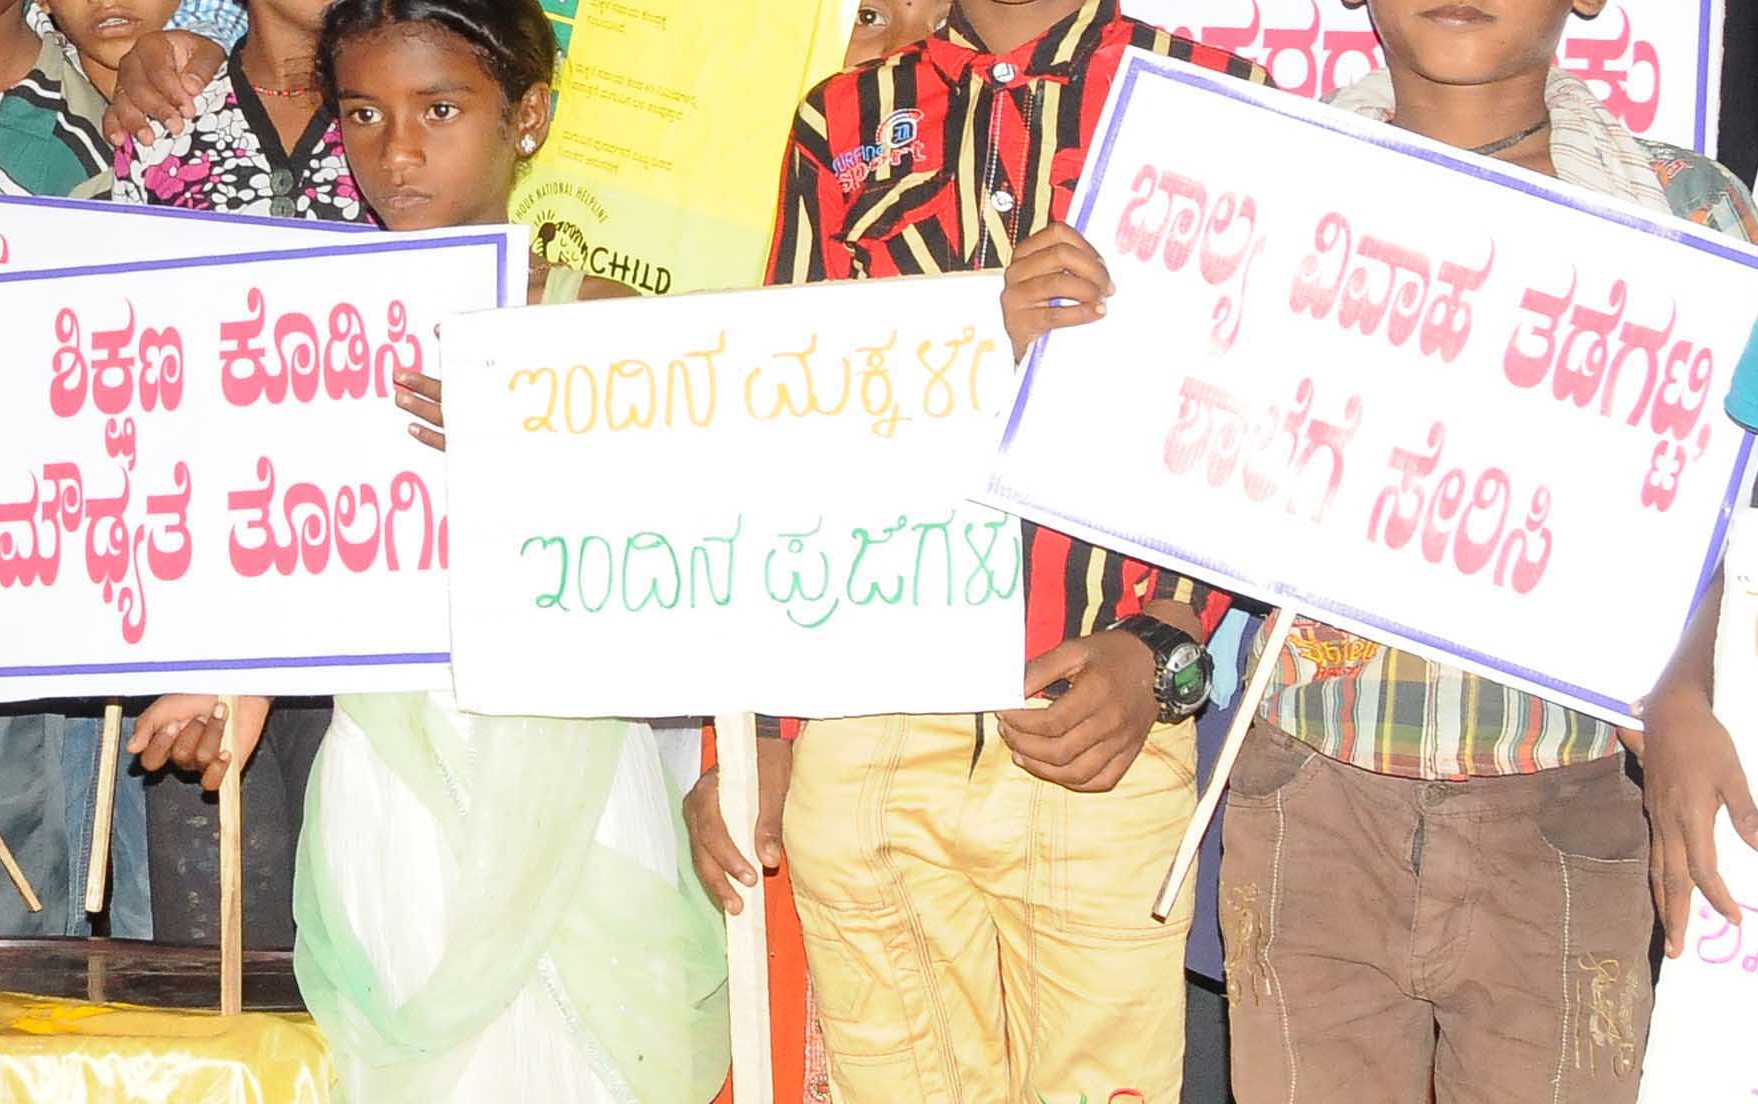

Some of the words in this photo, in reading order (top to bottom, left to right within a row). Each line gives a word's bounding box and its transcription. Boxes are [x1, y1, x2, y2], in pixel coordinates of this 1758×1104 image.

[590, 247, 671, 295] CHILD
[1289, 211, 1496, 363] ವಿವಾಹ
[49, 296, 184, 471] ಶಿಕ್ಷಣ
[227, 456, 449, 578] ತೊಲಗಿ
[1367, 420, 1552, 596] ಸೇರಿಸಿ
